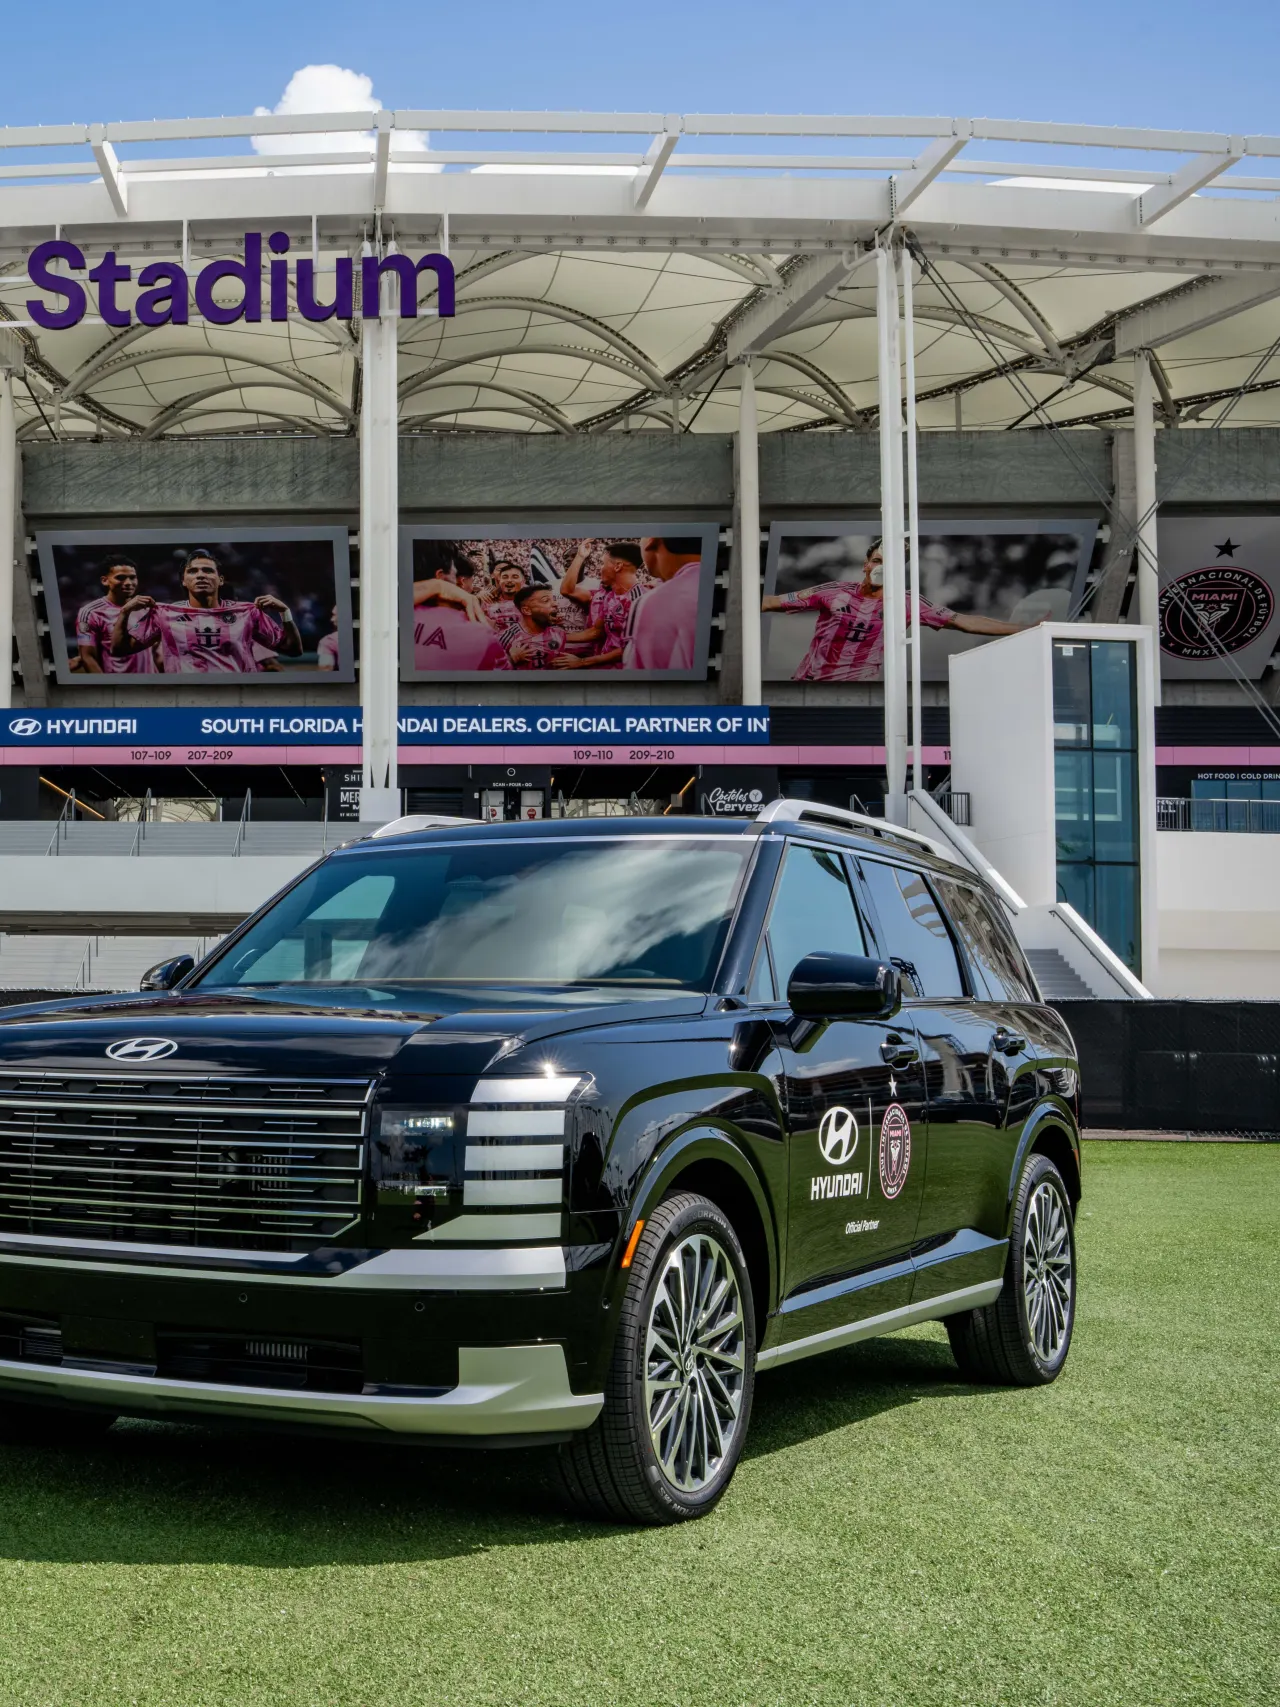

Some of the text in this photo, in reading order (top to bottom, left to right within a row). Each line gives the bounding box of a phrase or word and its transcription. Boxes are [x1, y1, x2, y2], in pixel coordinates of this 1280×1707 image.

[25, 231, 455, 330] Stadium
[1192, 593, 1238, 601] MIAMI
[47, 719, 137, 734] HYUNDAI
[201, 718, 264, 734] SOUTH
[269, 718, 348, 733] FLORIDA
[352, 718, 438, 733] HNDAI
[443, 717, 532, 733] DEALERS.
[536, 717, 621, 733] OFFICIAL
[626, 717, 713, 733] PARTNER
[716, 717, 743, 733] OF
[130, 750, 233, 761] 107-109 207-209
[573, 750, 675, 760] 109-110 209-210
[344, 774, 363, 782] SHI
[810, 1172, 863, 1200] HYUNDAI
[845, 1220, 880, 1234] Official Partner
